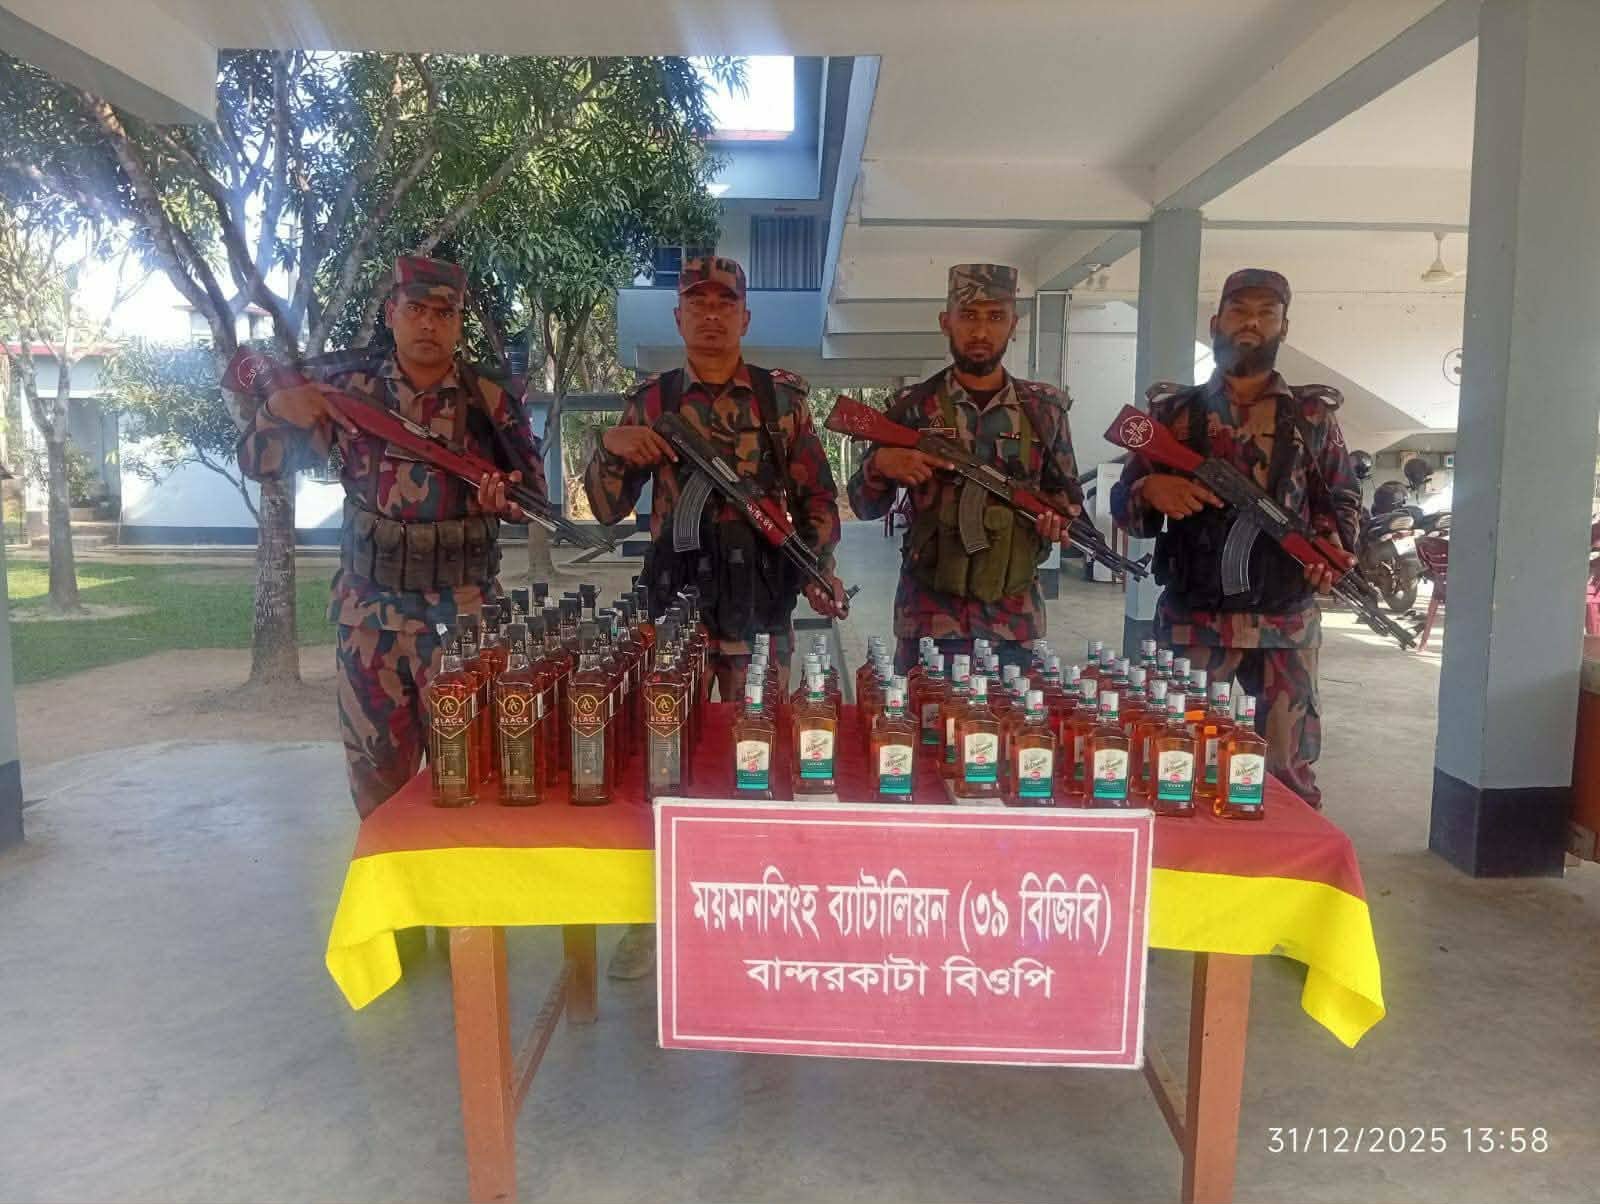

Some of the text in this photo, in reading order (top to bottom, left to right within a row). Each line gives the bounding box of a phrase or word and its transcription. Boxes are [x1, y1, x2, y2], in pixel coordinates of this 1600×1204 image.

[690, 866, 1111, 956] ময়মনসিংহ ব্যাটালিয়ন (৩৯ বিজিবি)
[743, 954, 1054, 998] বান্দরকাটা বিওপি
